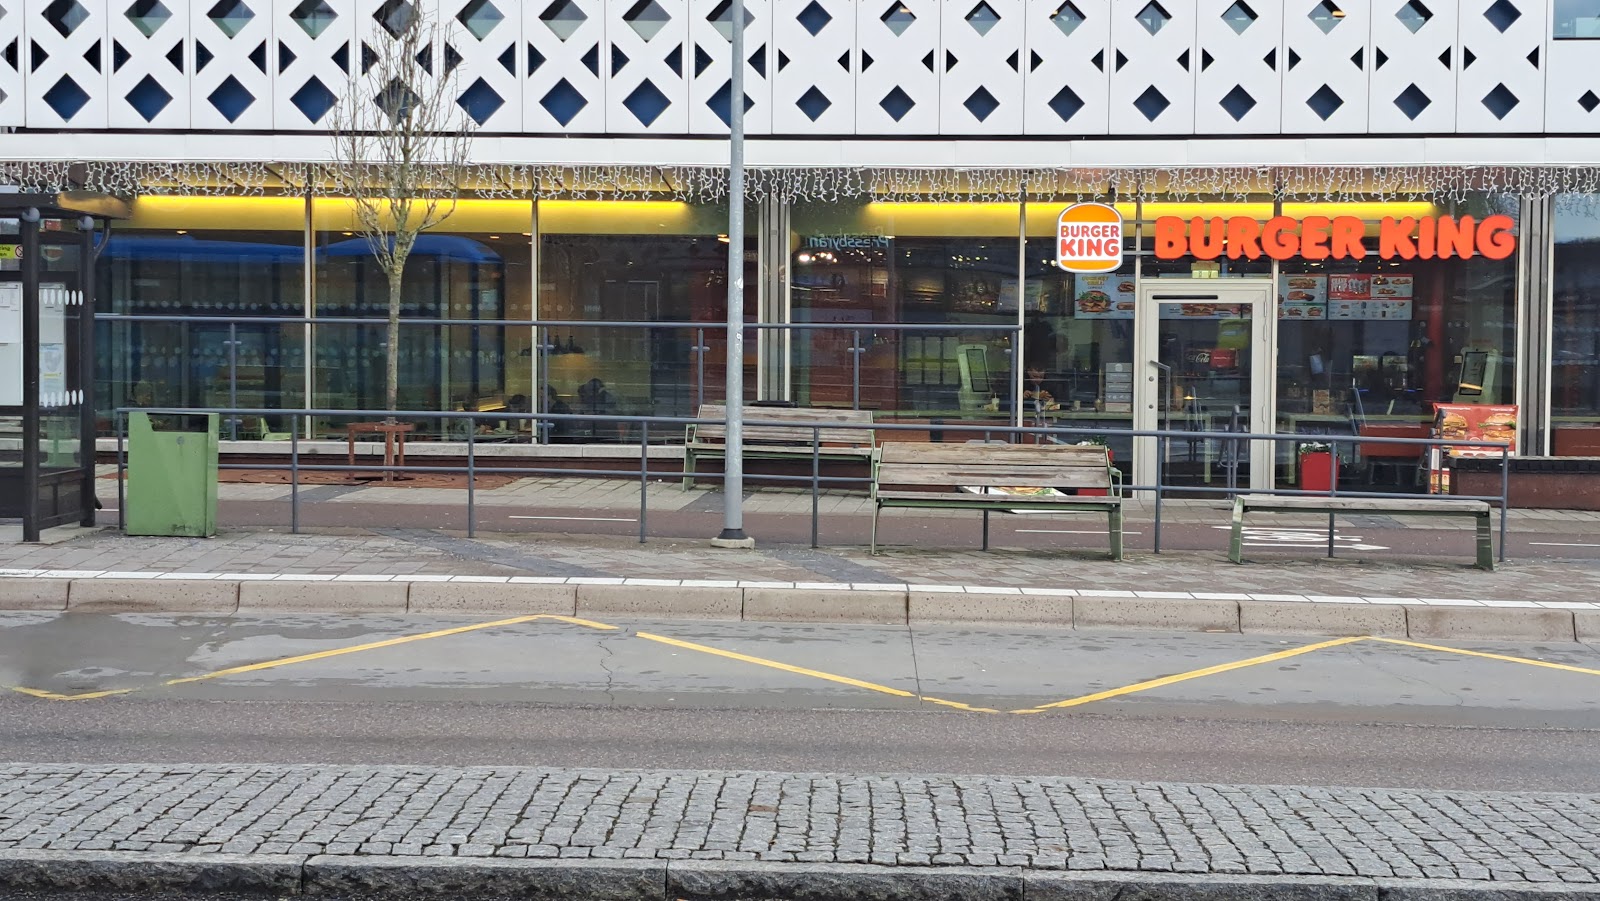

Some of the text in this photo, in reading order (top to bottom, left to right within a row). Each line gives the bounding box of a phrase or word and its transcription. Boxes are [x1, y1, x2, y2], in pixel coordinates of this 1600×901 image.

[1060, 225, 1120, 238] BURGER
[1155, 214, 1516, 260] BURGER KING
[1060, 238, 1120, 257] KING
